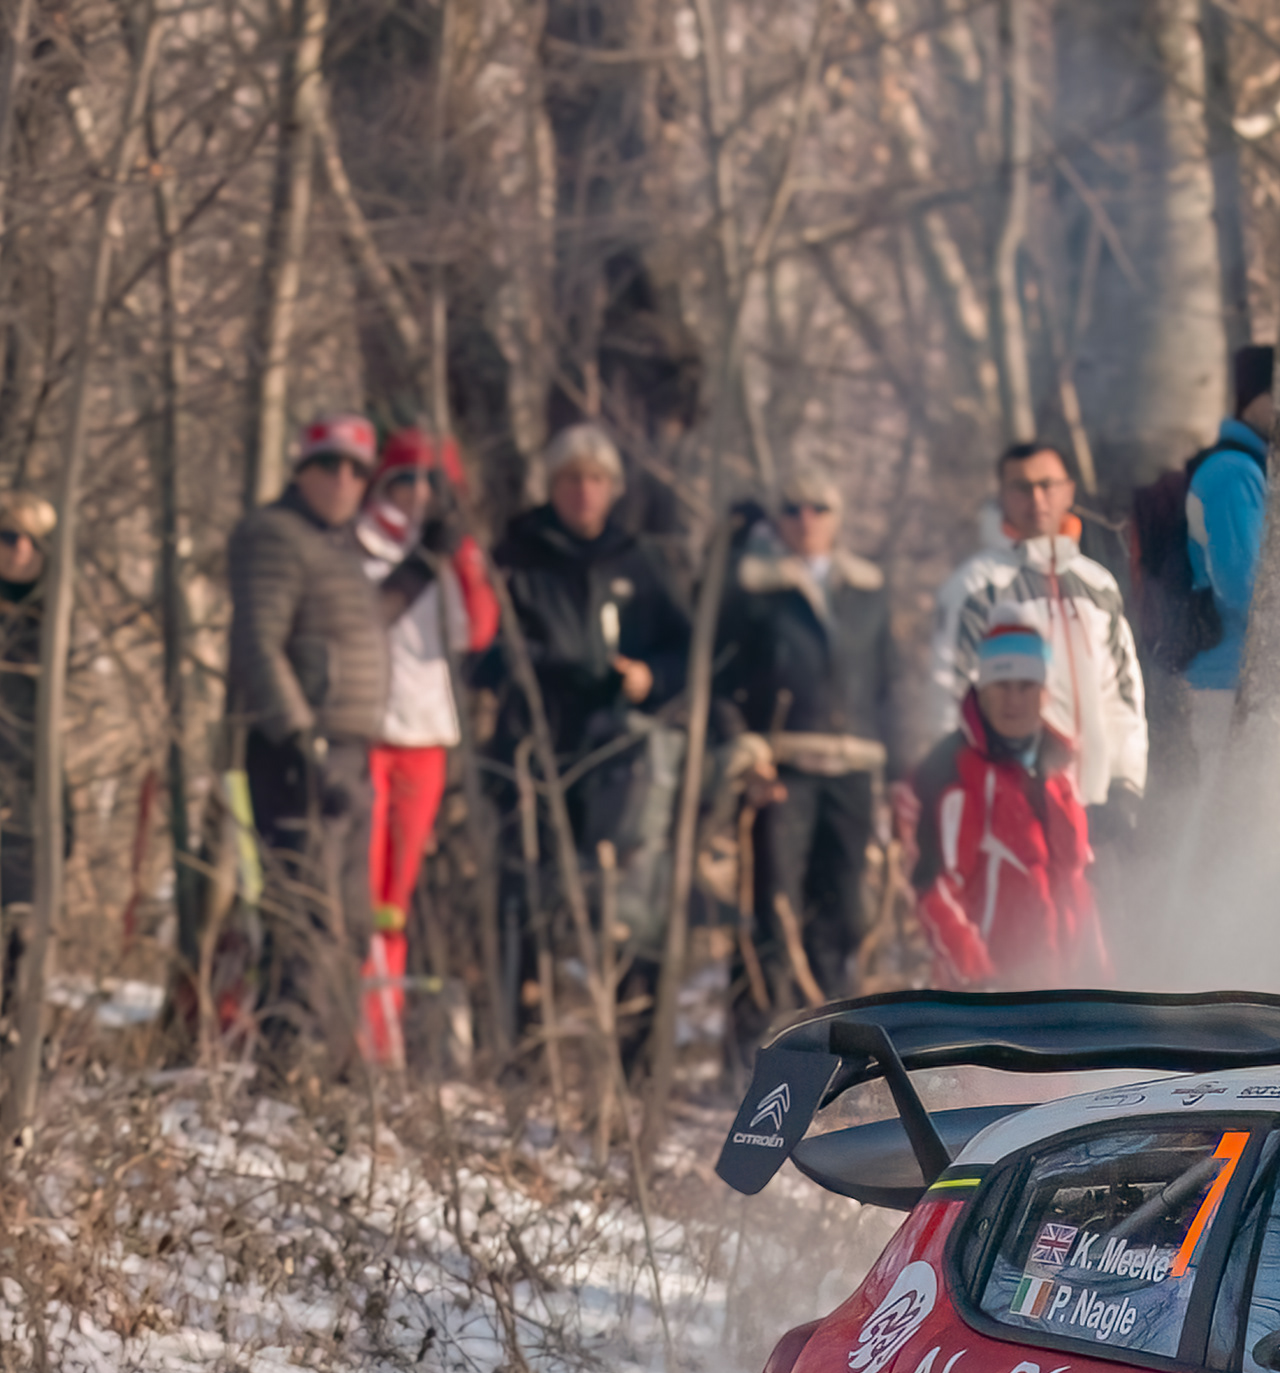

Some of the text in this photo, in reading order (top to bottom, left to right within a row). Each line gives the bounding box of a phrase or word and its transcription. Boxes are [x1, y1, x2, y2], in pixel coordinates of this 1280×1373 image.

[1070, 1231, 1172, 1283] K. Meeke
[1047, 1285, 1138, 1341] P. Nagle
